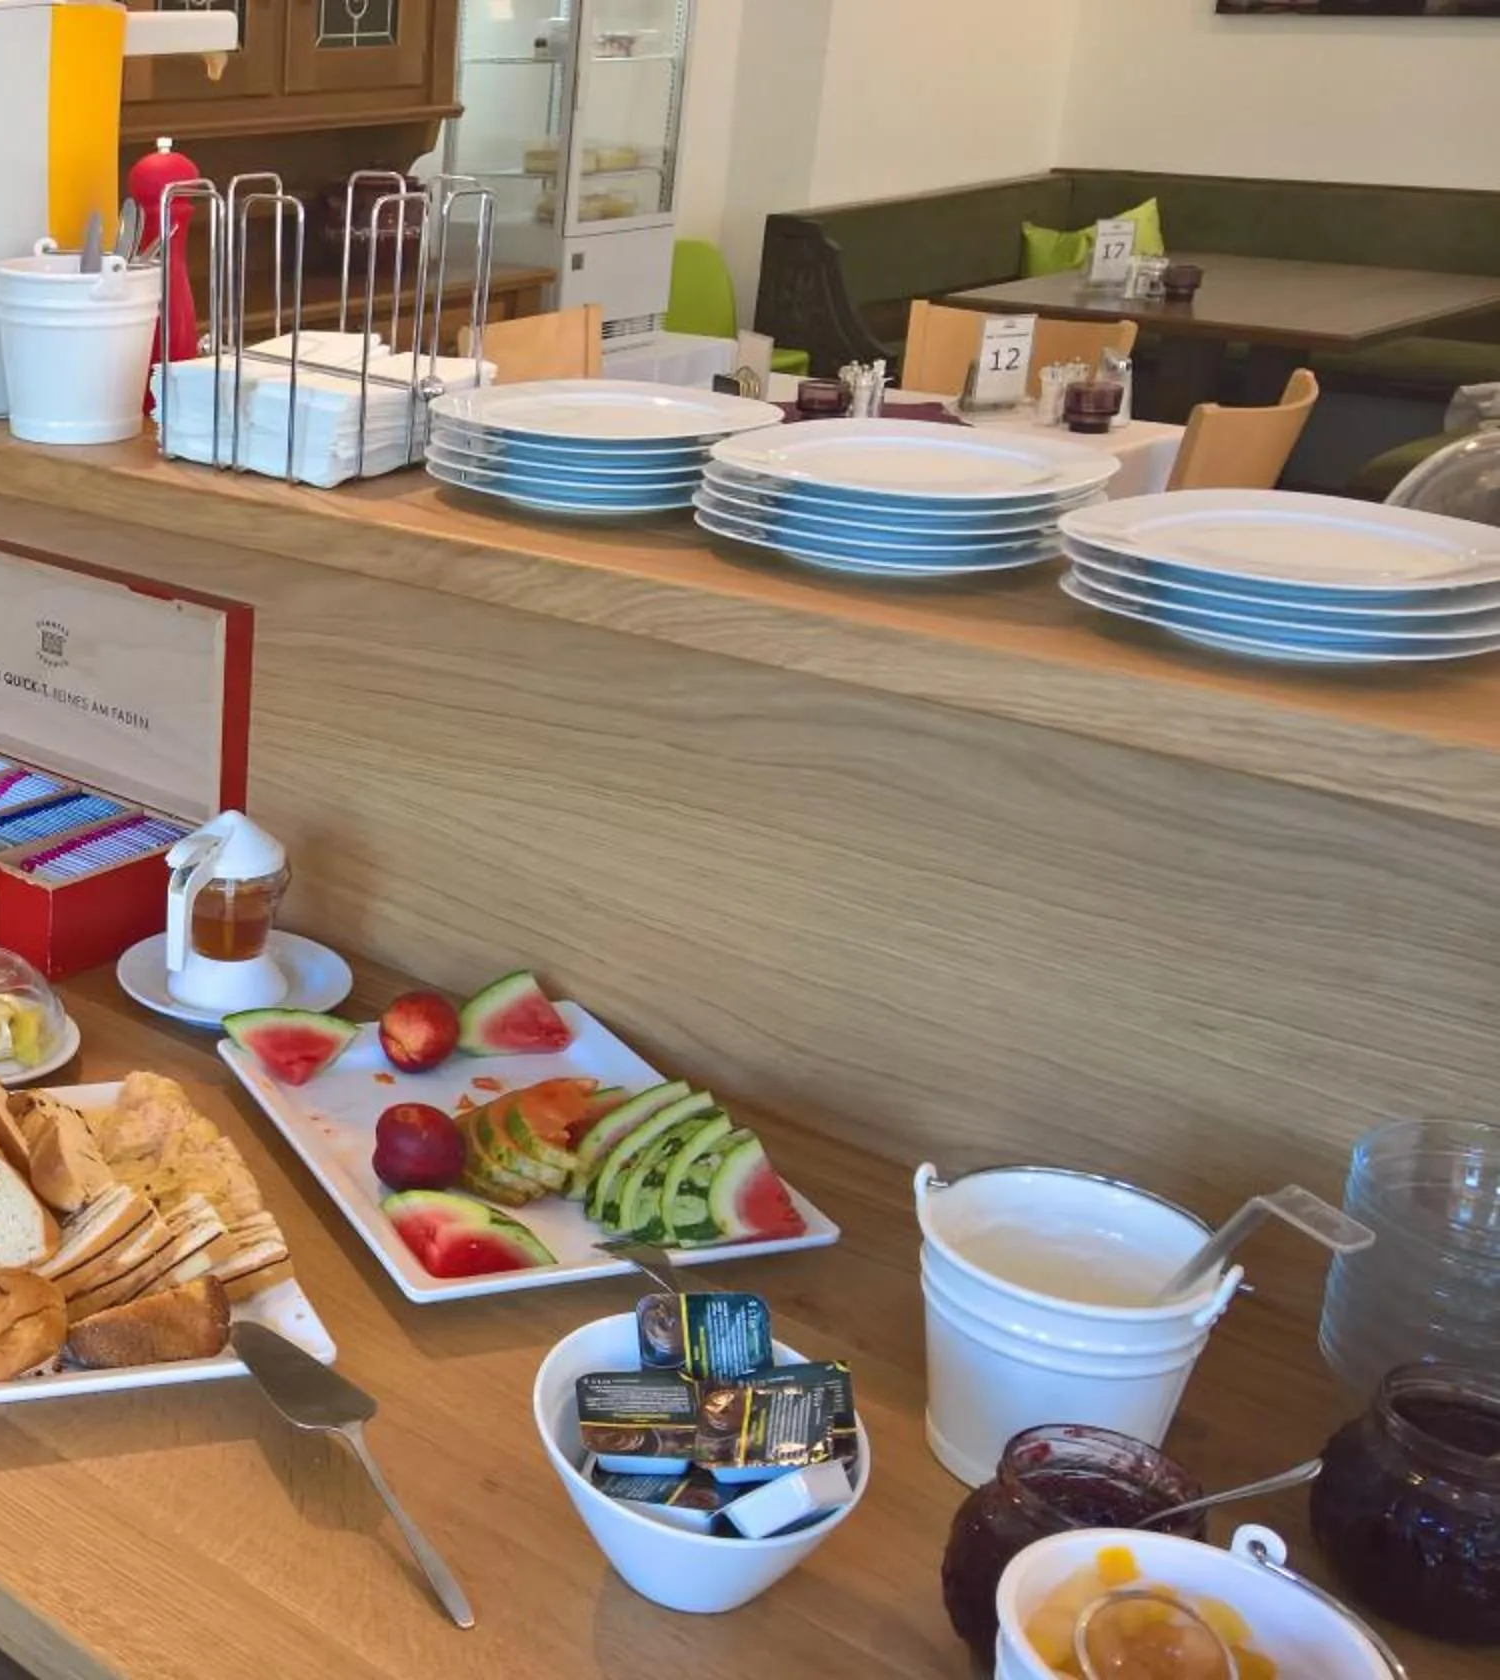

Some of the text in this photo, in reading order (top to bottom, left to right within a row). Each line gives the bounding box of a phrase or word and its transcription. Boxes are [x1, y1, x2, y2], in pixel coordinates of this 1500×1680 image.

[1104, 242, 1125, 259] 17
[988, 347, 1021, 371] 12
[91, 701, 109, 717] AM
